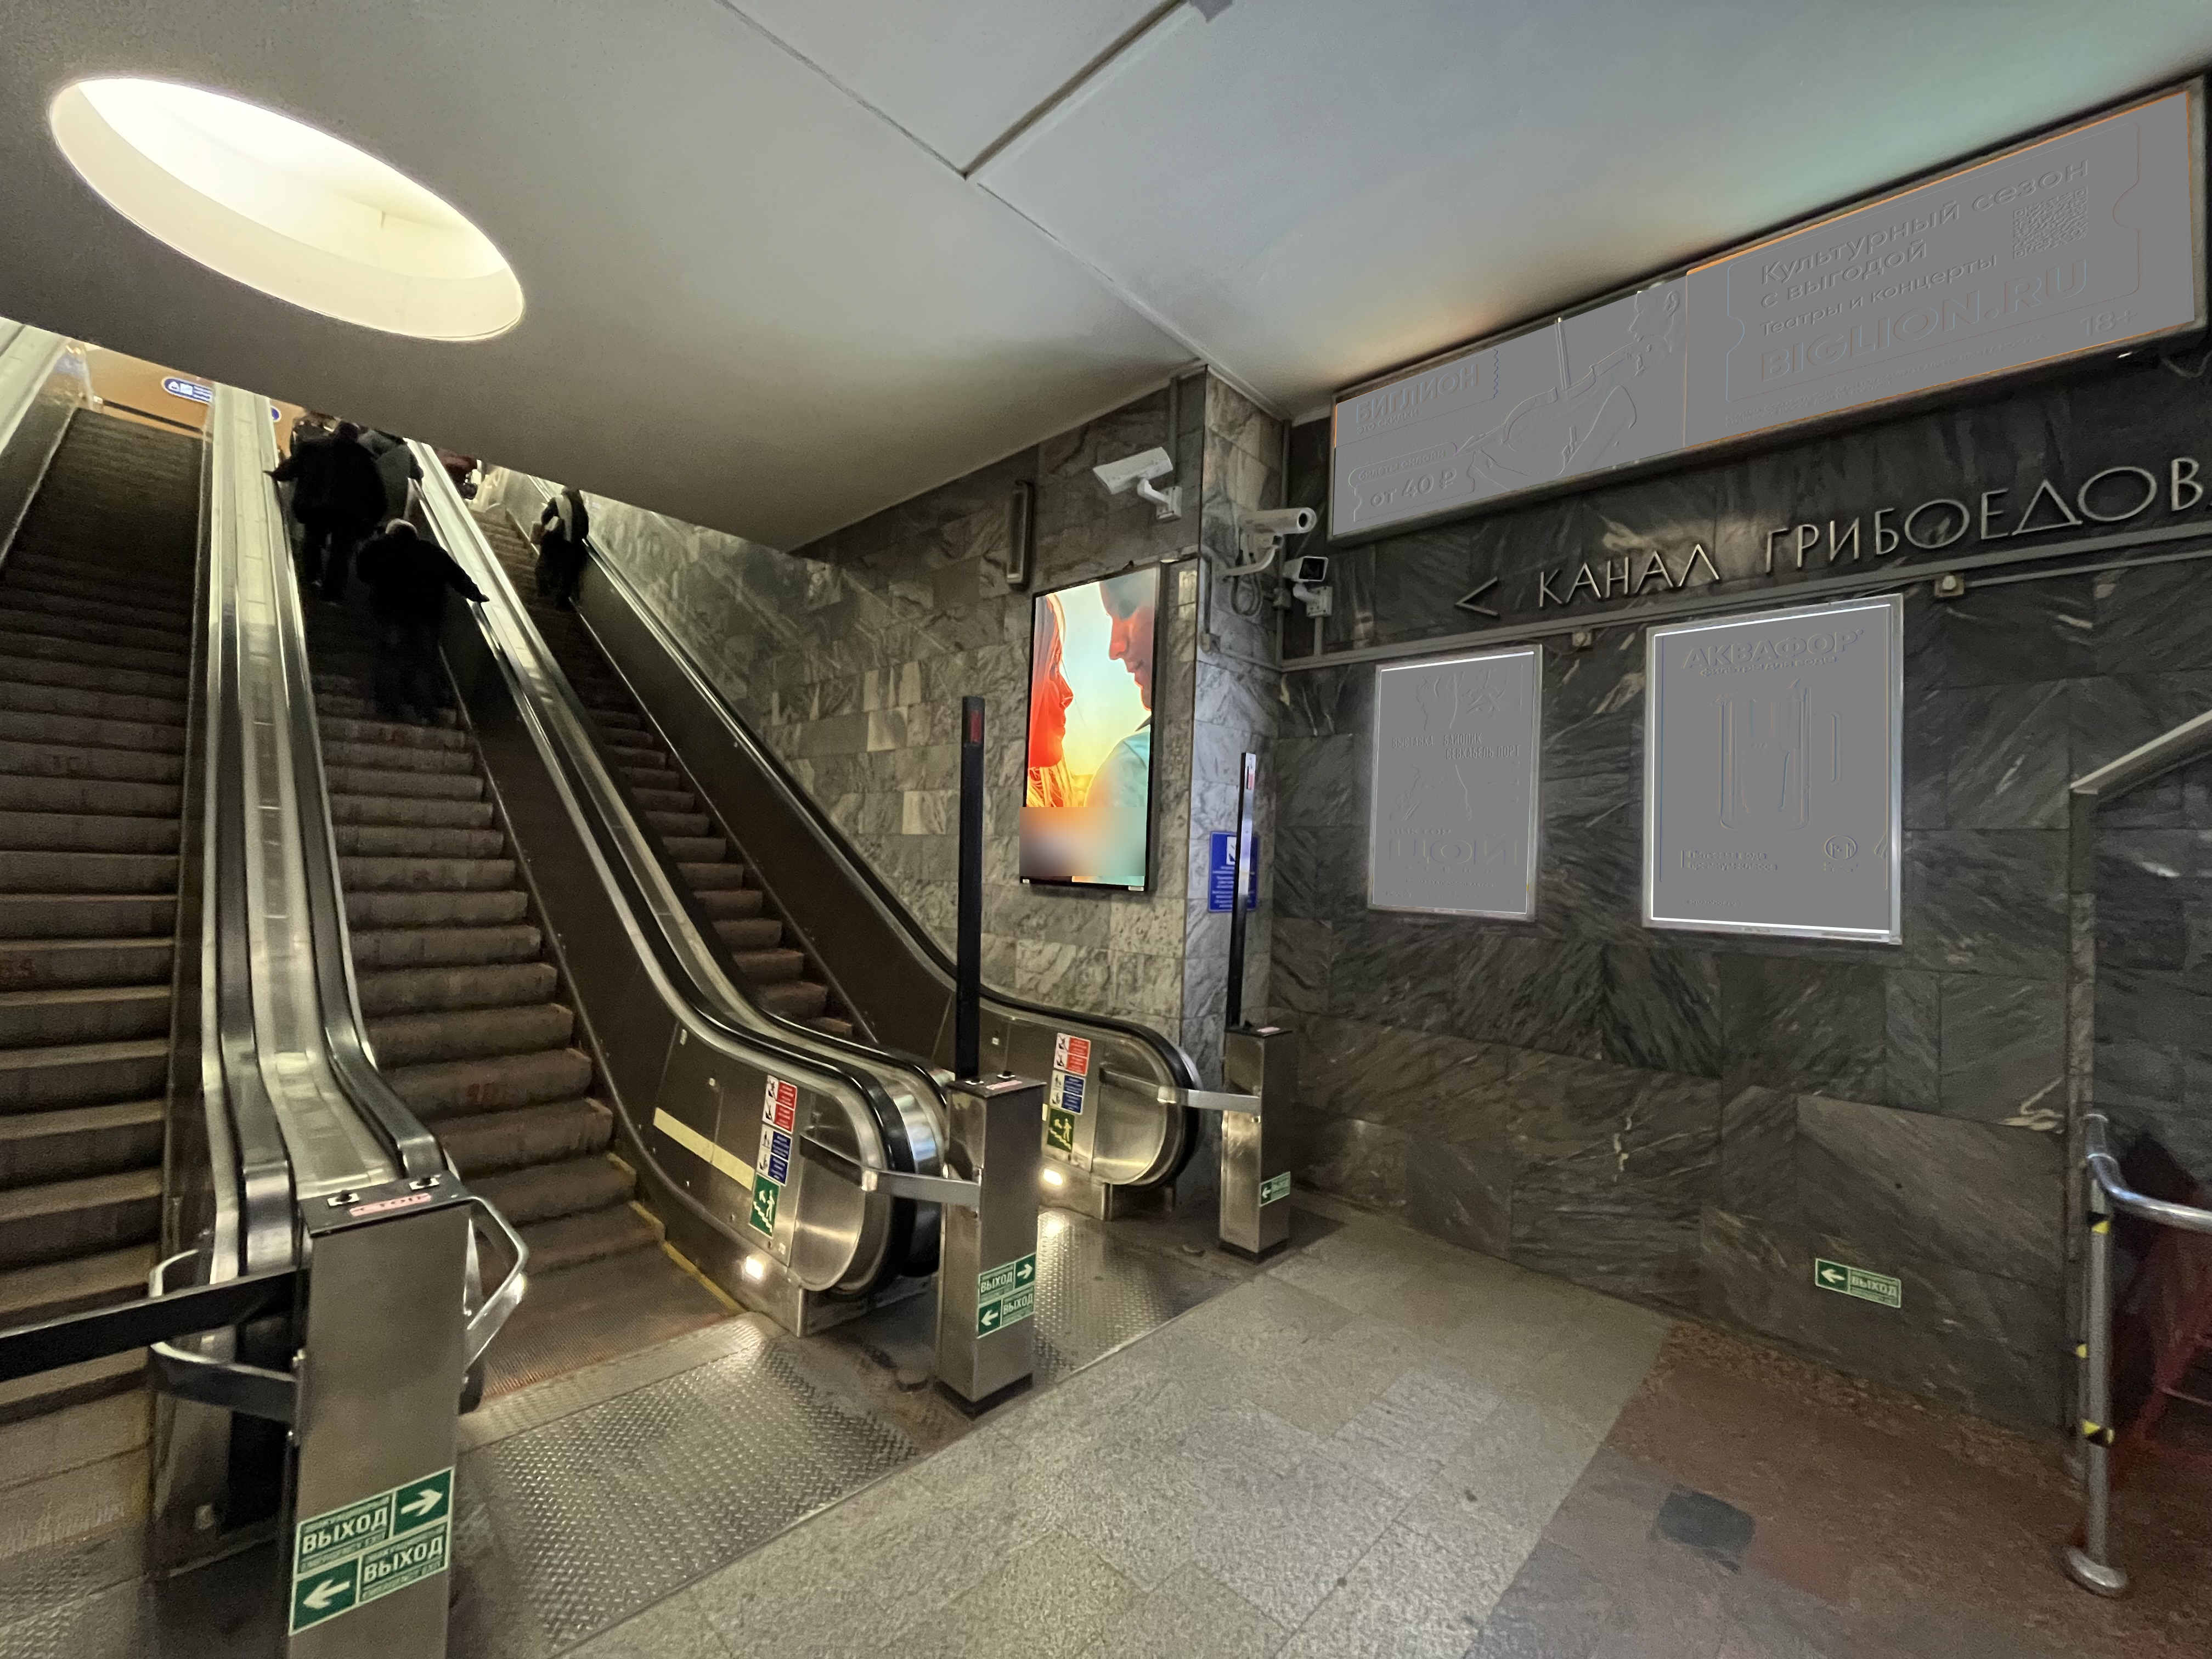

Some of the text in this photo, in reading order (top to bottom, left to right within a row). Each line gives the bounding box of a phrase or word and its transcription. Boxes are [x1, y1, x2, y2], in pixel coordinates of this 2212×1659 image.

[1762, 159, 2087, 284] Культурный сезон
[1762, 239, 1926, 308] с выгодой
[1760, 255, 1996, 336] Театры и концерты
[1762, 259, 2085, 382] BIGLION.RU
[2080, 310, 2137, 336] 18+
[1357, 364, 1477, 424] БИГЛИОН
[1402, 449, 1445, 467] онлайн
[1402, 474, 1433, 497] 40
[1539, 457, 2212, 607] КАНАЛ ГРИБОЕДОВ
[1684, 630, 1858, 669] АКВАФОР
[1701, 657, 1836, 676] фильтры для воды
[1392, 736, 1433, 748] ВЫСТАВКА
[1443, 732, 1481, 746] БАЙОПИК
[1446, 744, 1520, 760] СЕВКАБЕЛЬ ПОРТ
[1390, 832, 1516, 866] ЦОЙ
[980, 1272, 1013, 1293] ВЫХОД
[1852, 1276, 1898, 1296] ВЫХОД
[1003, 1293, 1033, 1315] ВЫХОД
[302, 1506, 388, 1554] ВЫХОД
[363, 1536, 443, 1582] ВЫХОД
